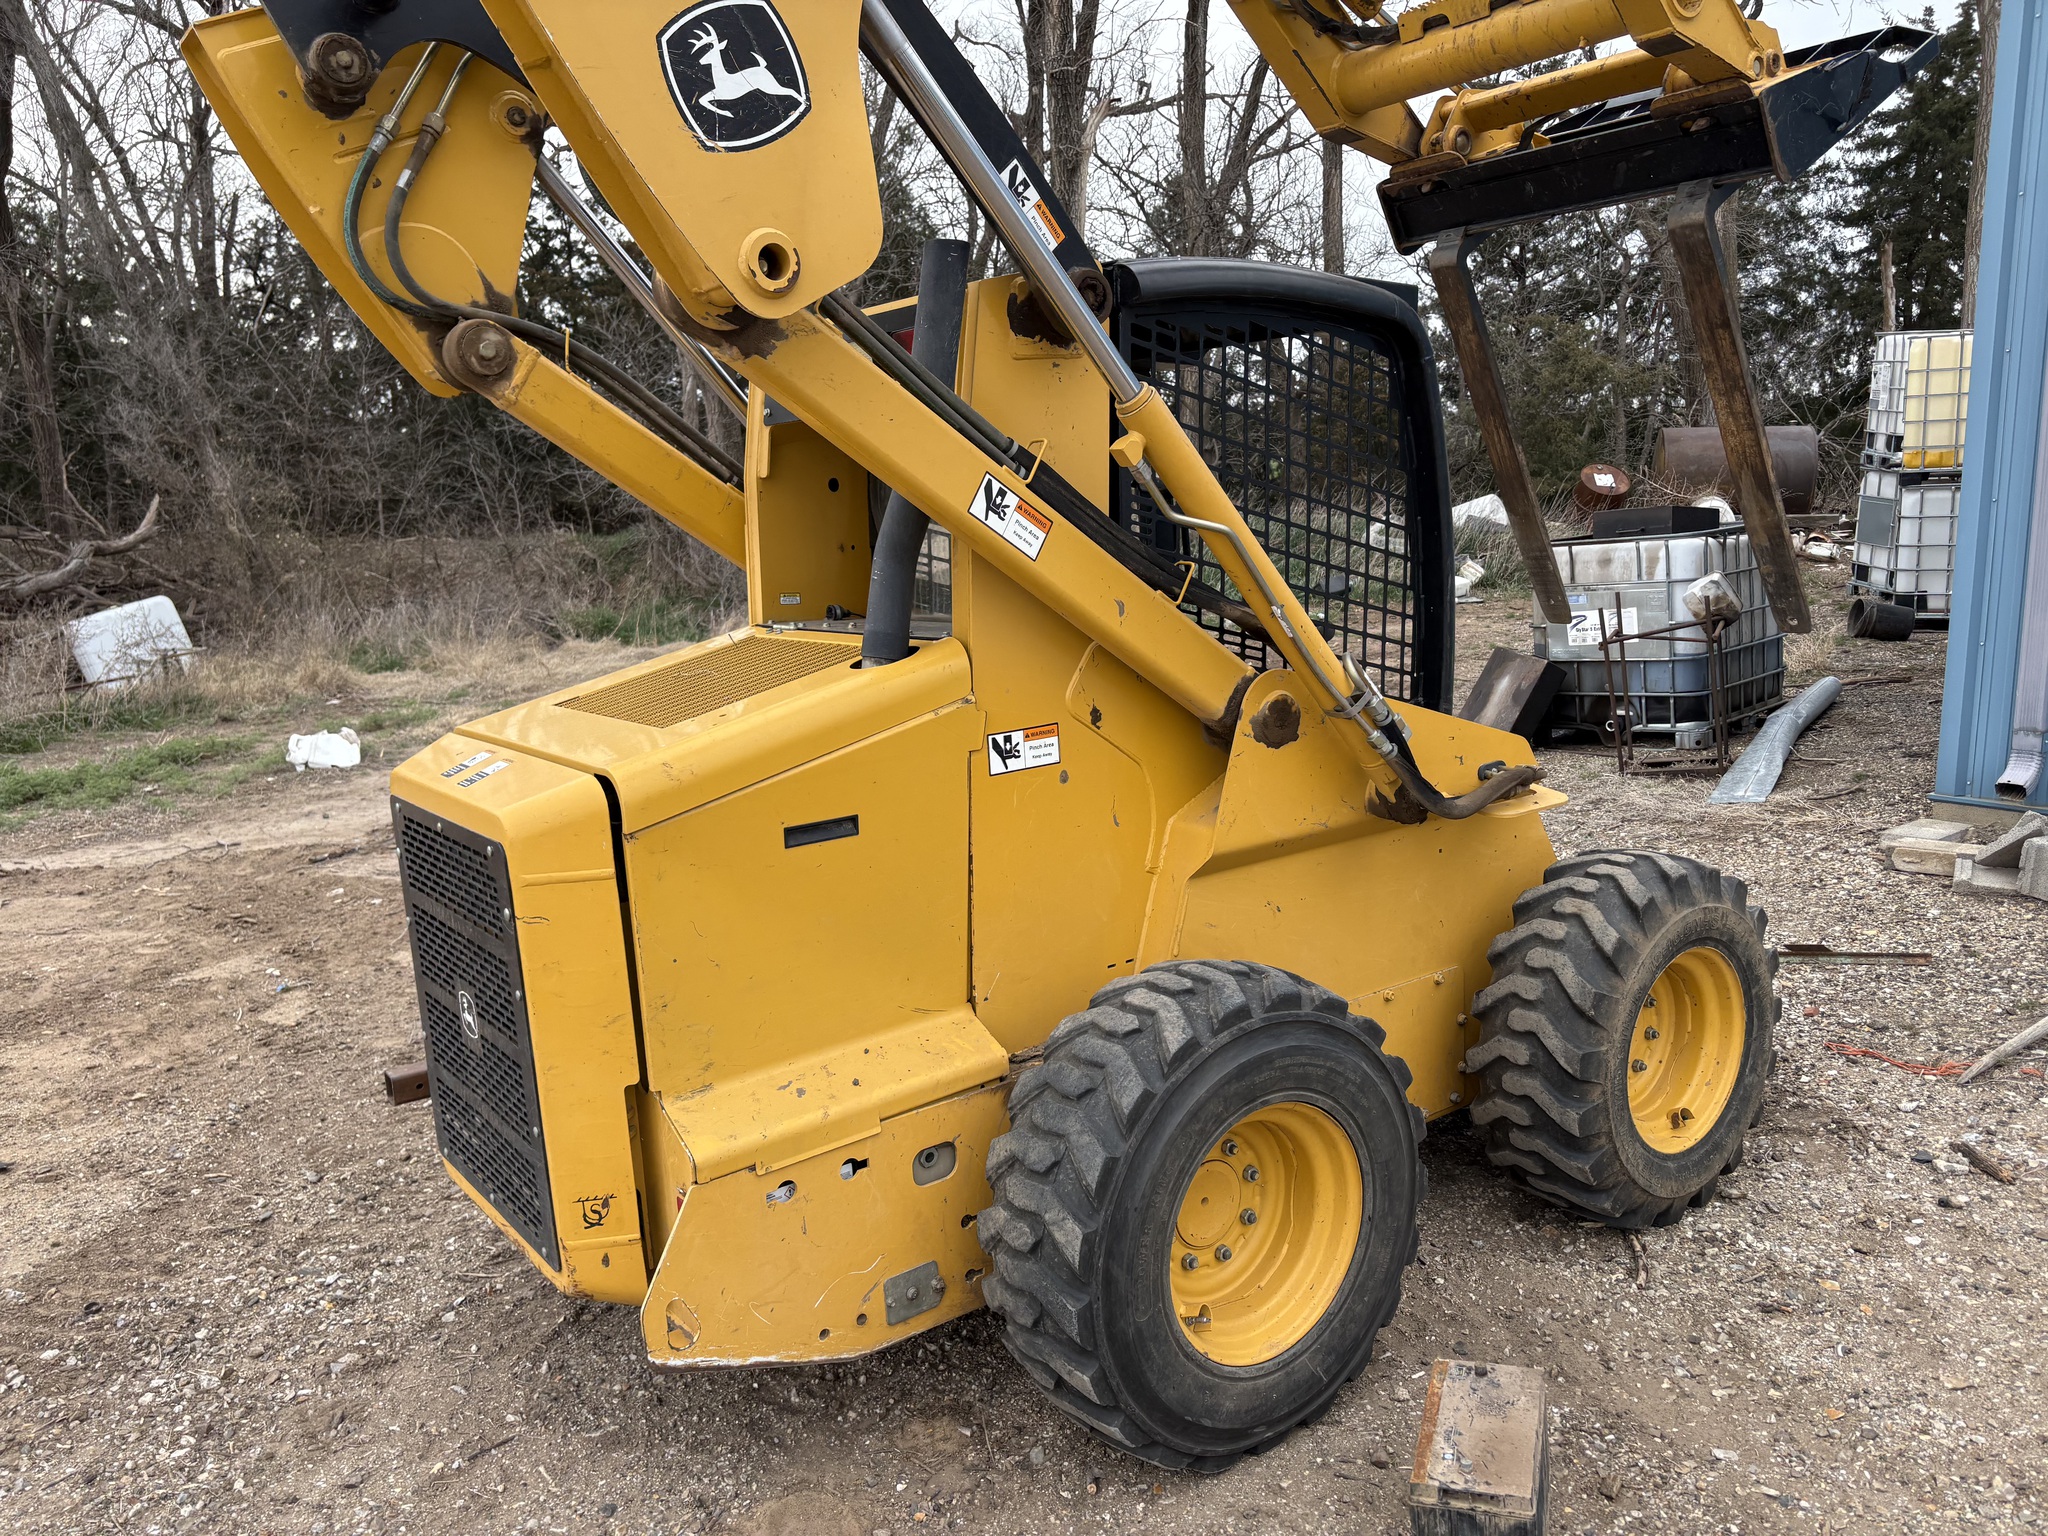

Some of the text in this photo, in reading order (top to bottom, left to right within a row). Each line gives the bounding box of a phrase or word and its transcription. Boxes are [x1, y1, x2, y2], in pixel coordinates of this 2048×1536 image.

[1031, 215, 1051, 246] Pinch Area
[1041, 209, 1061, 239] WARNING
[1023, 507, 1047, 529] WARNING
[1013, 530, 1033, 547] Keep Away
[1015, 519, 1040, 541] Pinch Area
[1030, 728, 1055, 738] WARNING
